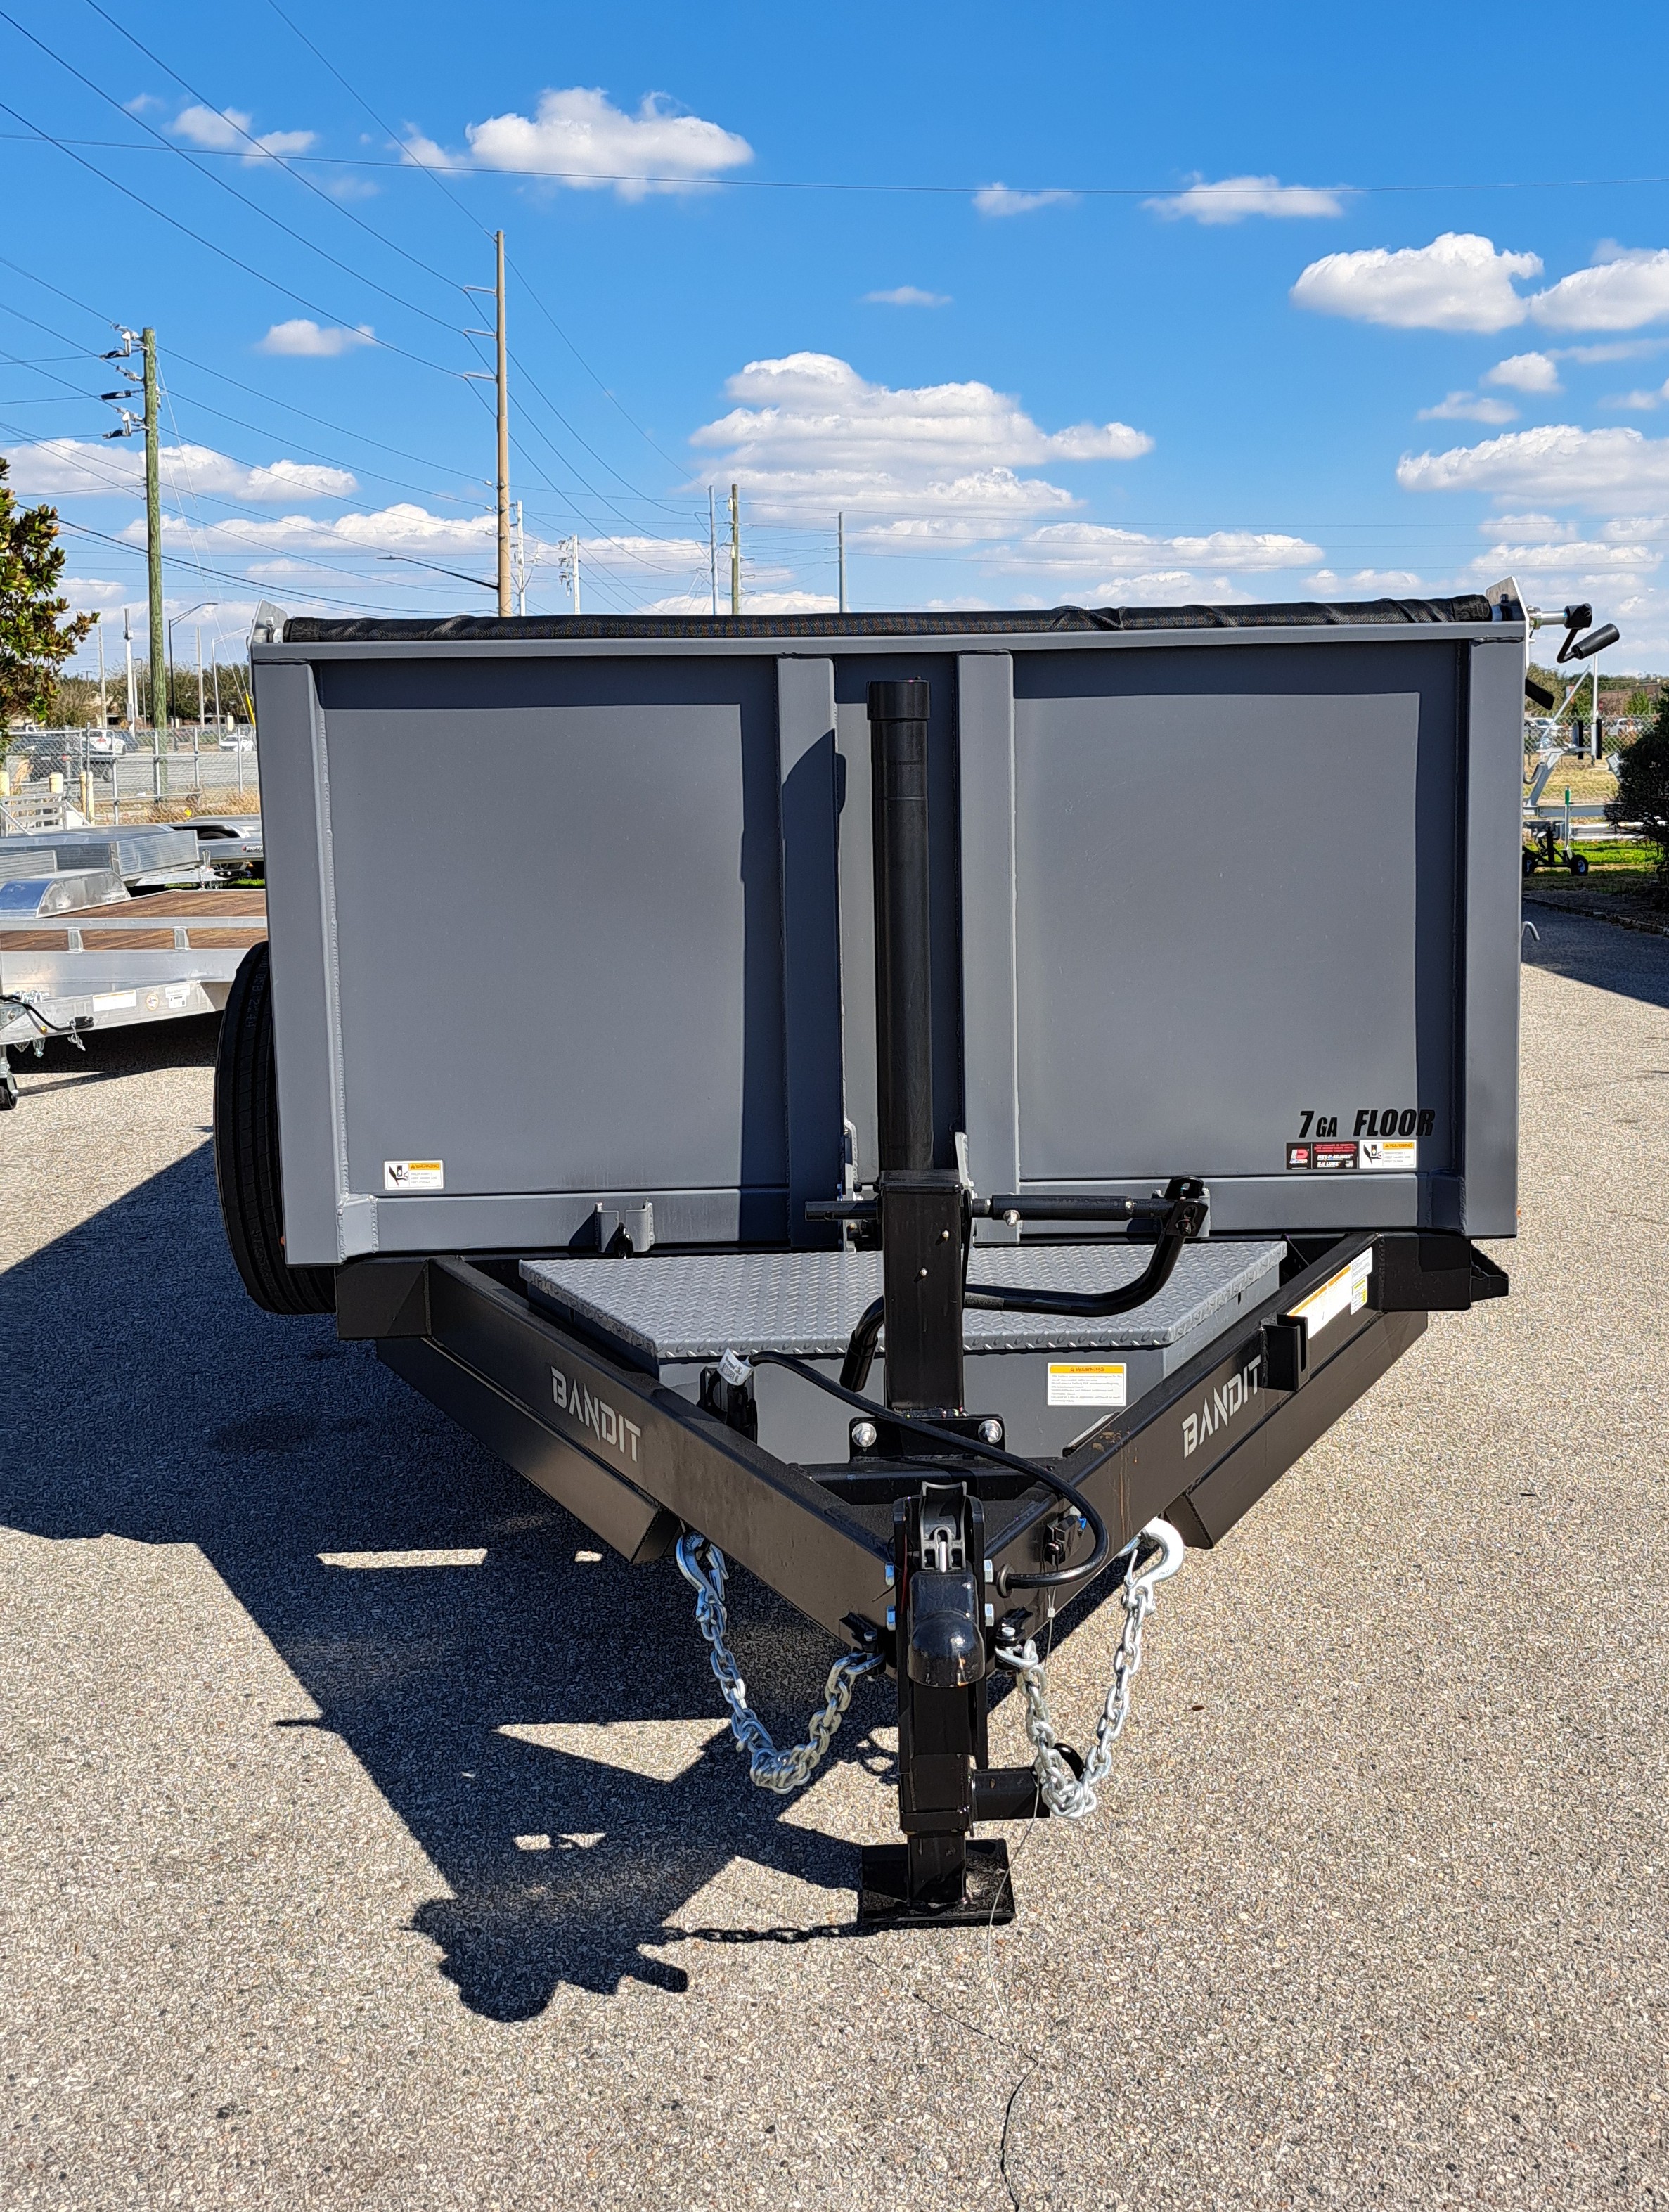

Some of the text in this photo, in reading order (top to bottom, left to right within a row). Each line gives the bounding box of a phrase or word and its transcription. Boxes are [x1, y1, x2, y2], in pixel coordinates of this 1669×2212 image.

[1299, 1108, 1436, 1138] 7 GA FLOOR
[550, 1365, 642, 1462] BANDIT
[1181, 1354, 1262, 1460] BANDIT
